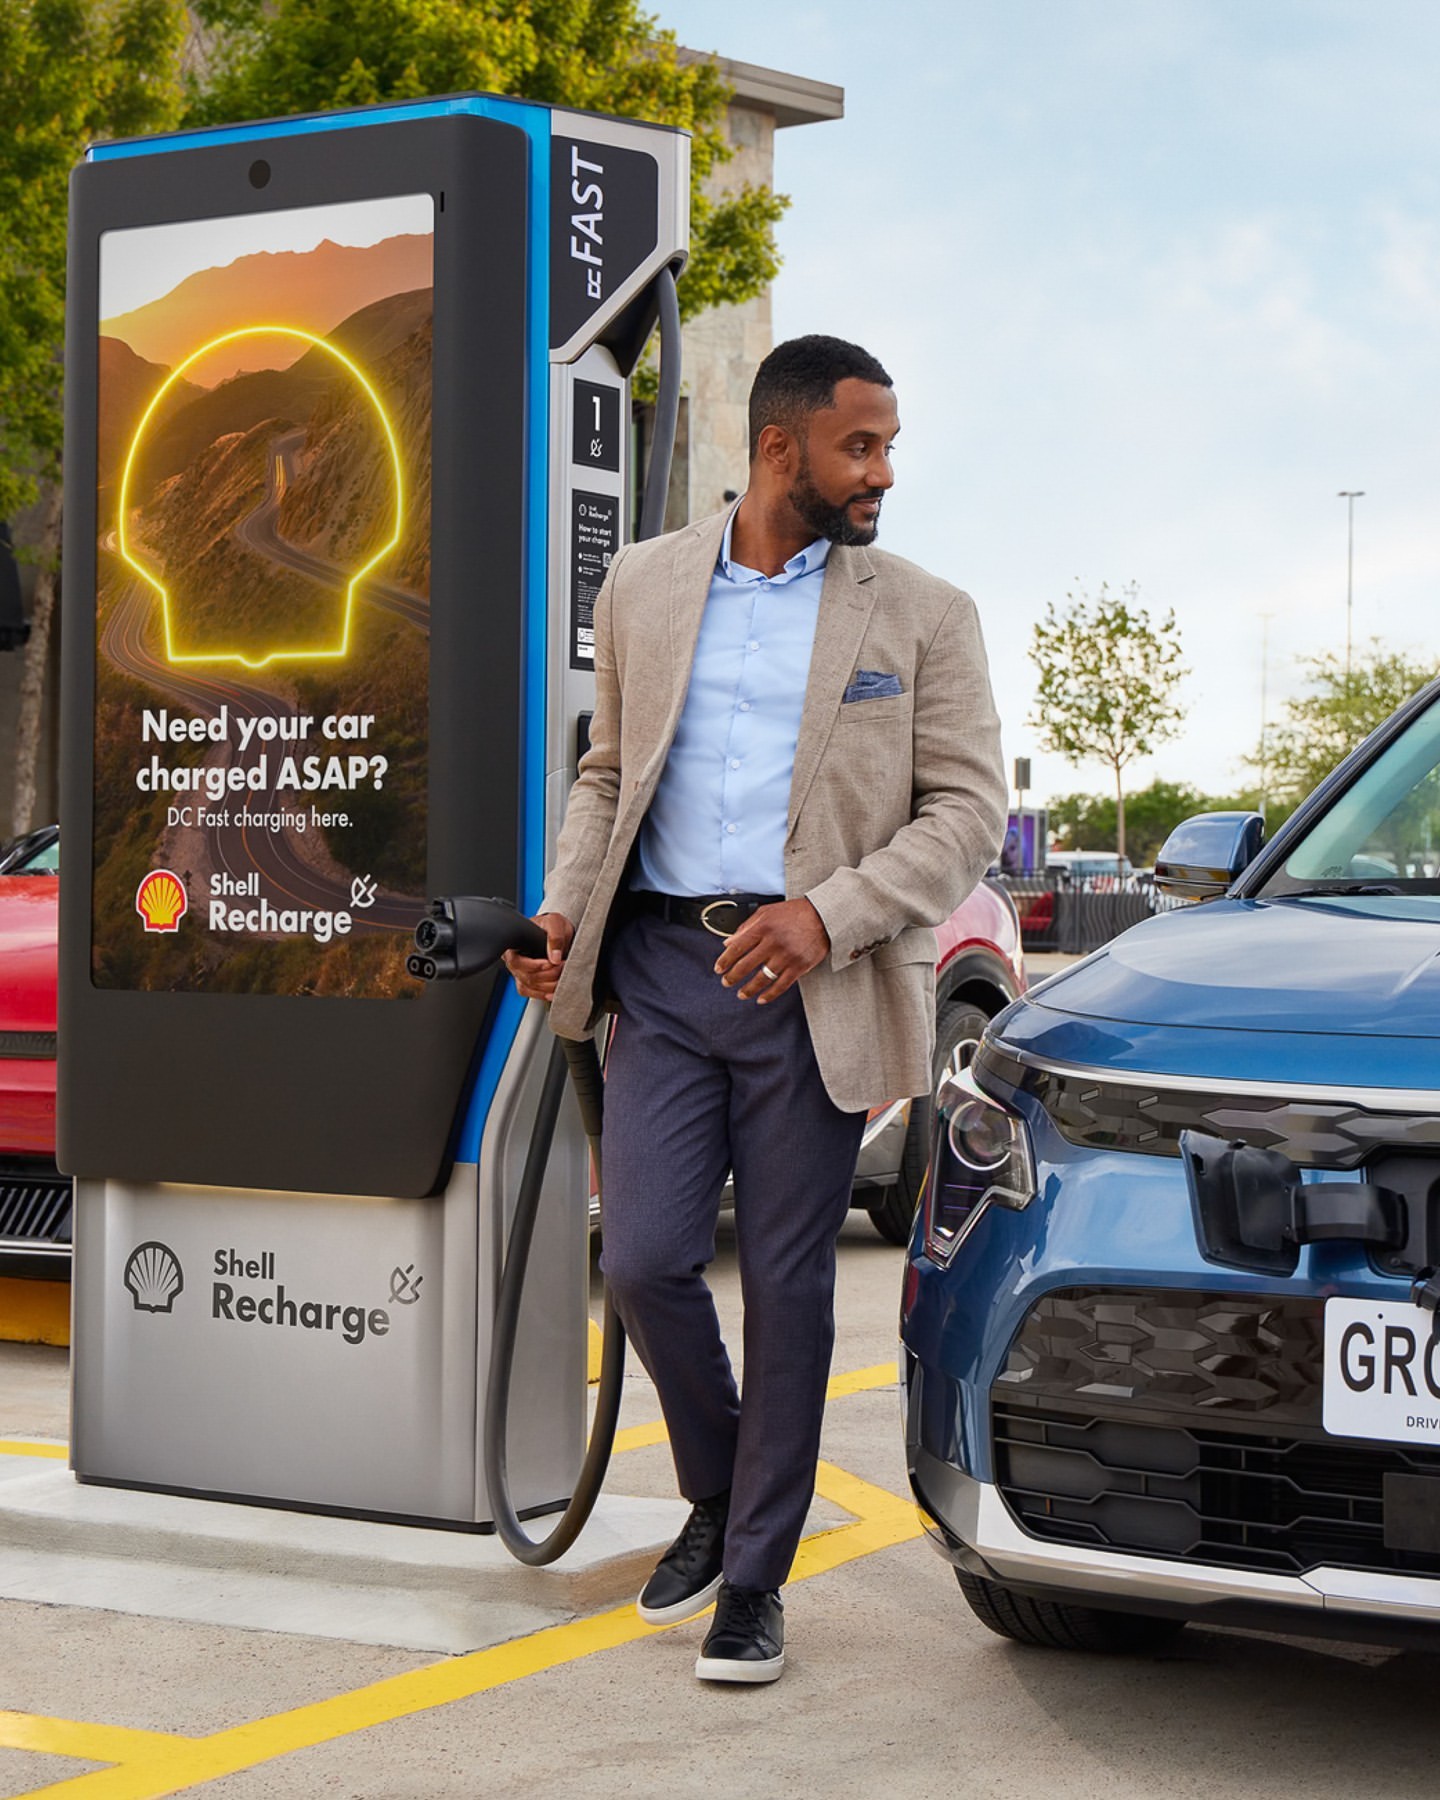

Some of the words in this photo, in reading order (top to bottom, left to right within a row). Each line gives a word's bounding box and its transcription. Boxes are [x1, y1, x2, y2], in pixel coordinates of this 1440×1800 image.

[571, 145, 604, 266] FAST
[592, 395, 601, 431] 1
[578, 523, 591, 532] How
[578, 535, 591, 543] your
[591, 536, 611, 547] charge
[142, 705, 228, 742] Need
[236, 715, 313, 751] your
[322, 714, 375, 739] car
[136, 754, 267, 801] charged
[275, 755, 388, 790] ASAP?
[167, 807, 192, 827] DC
[197, 807, 229, 828] Fast
[233, 805, 306, 832] charging
[311, 805, 353, 828] here.
[210, 872, 259, 896] Shell
[208, 898, 352, 943] Recharge
[213, 1248, 275, 1280] Shell
[212, 1282, 390, 1345] Recharge
[1406, 1416, 1440, 1430] DRIV
